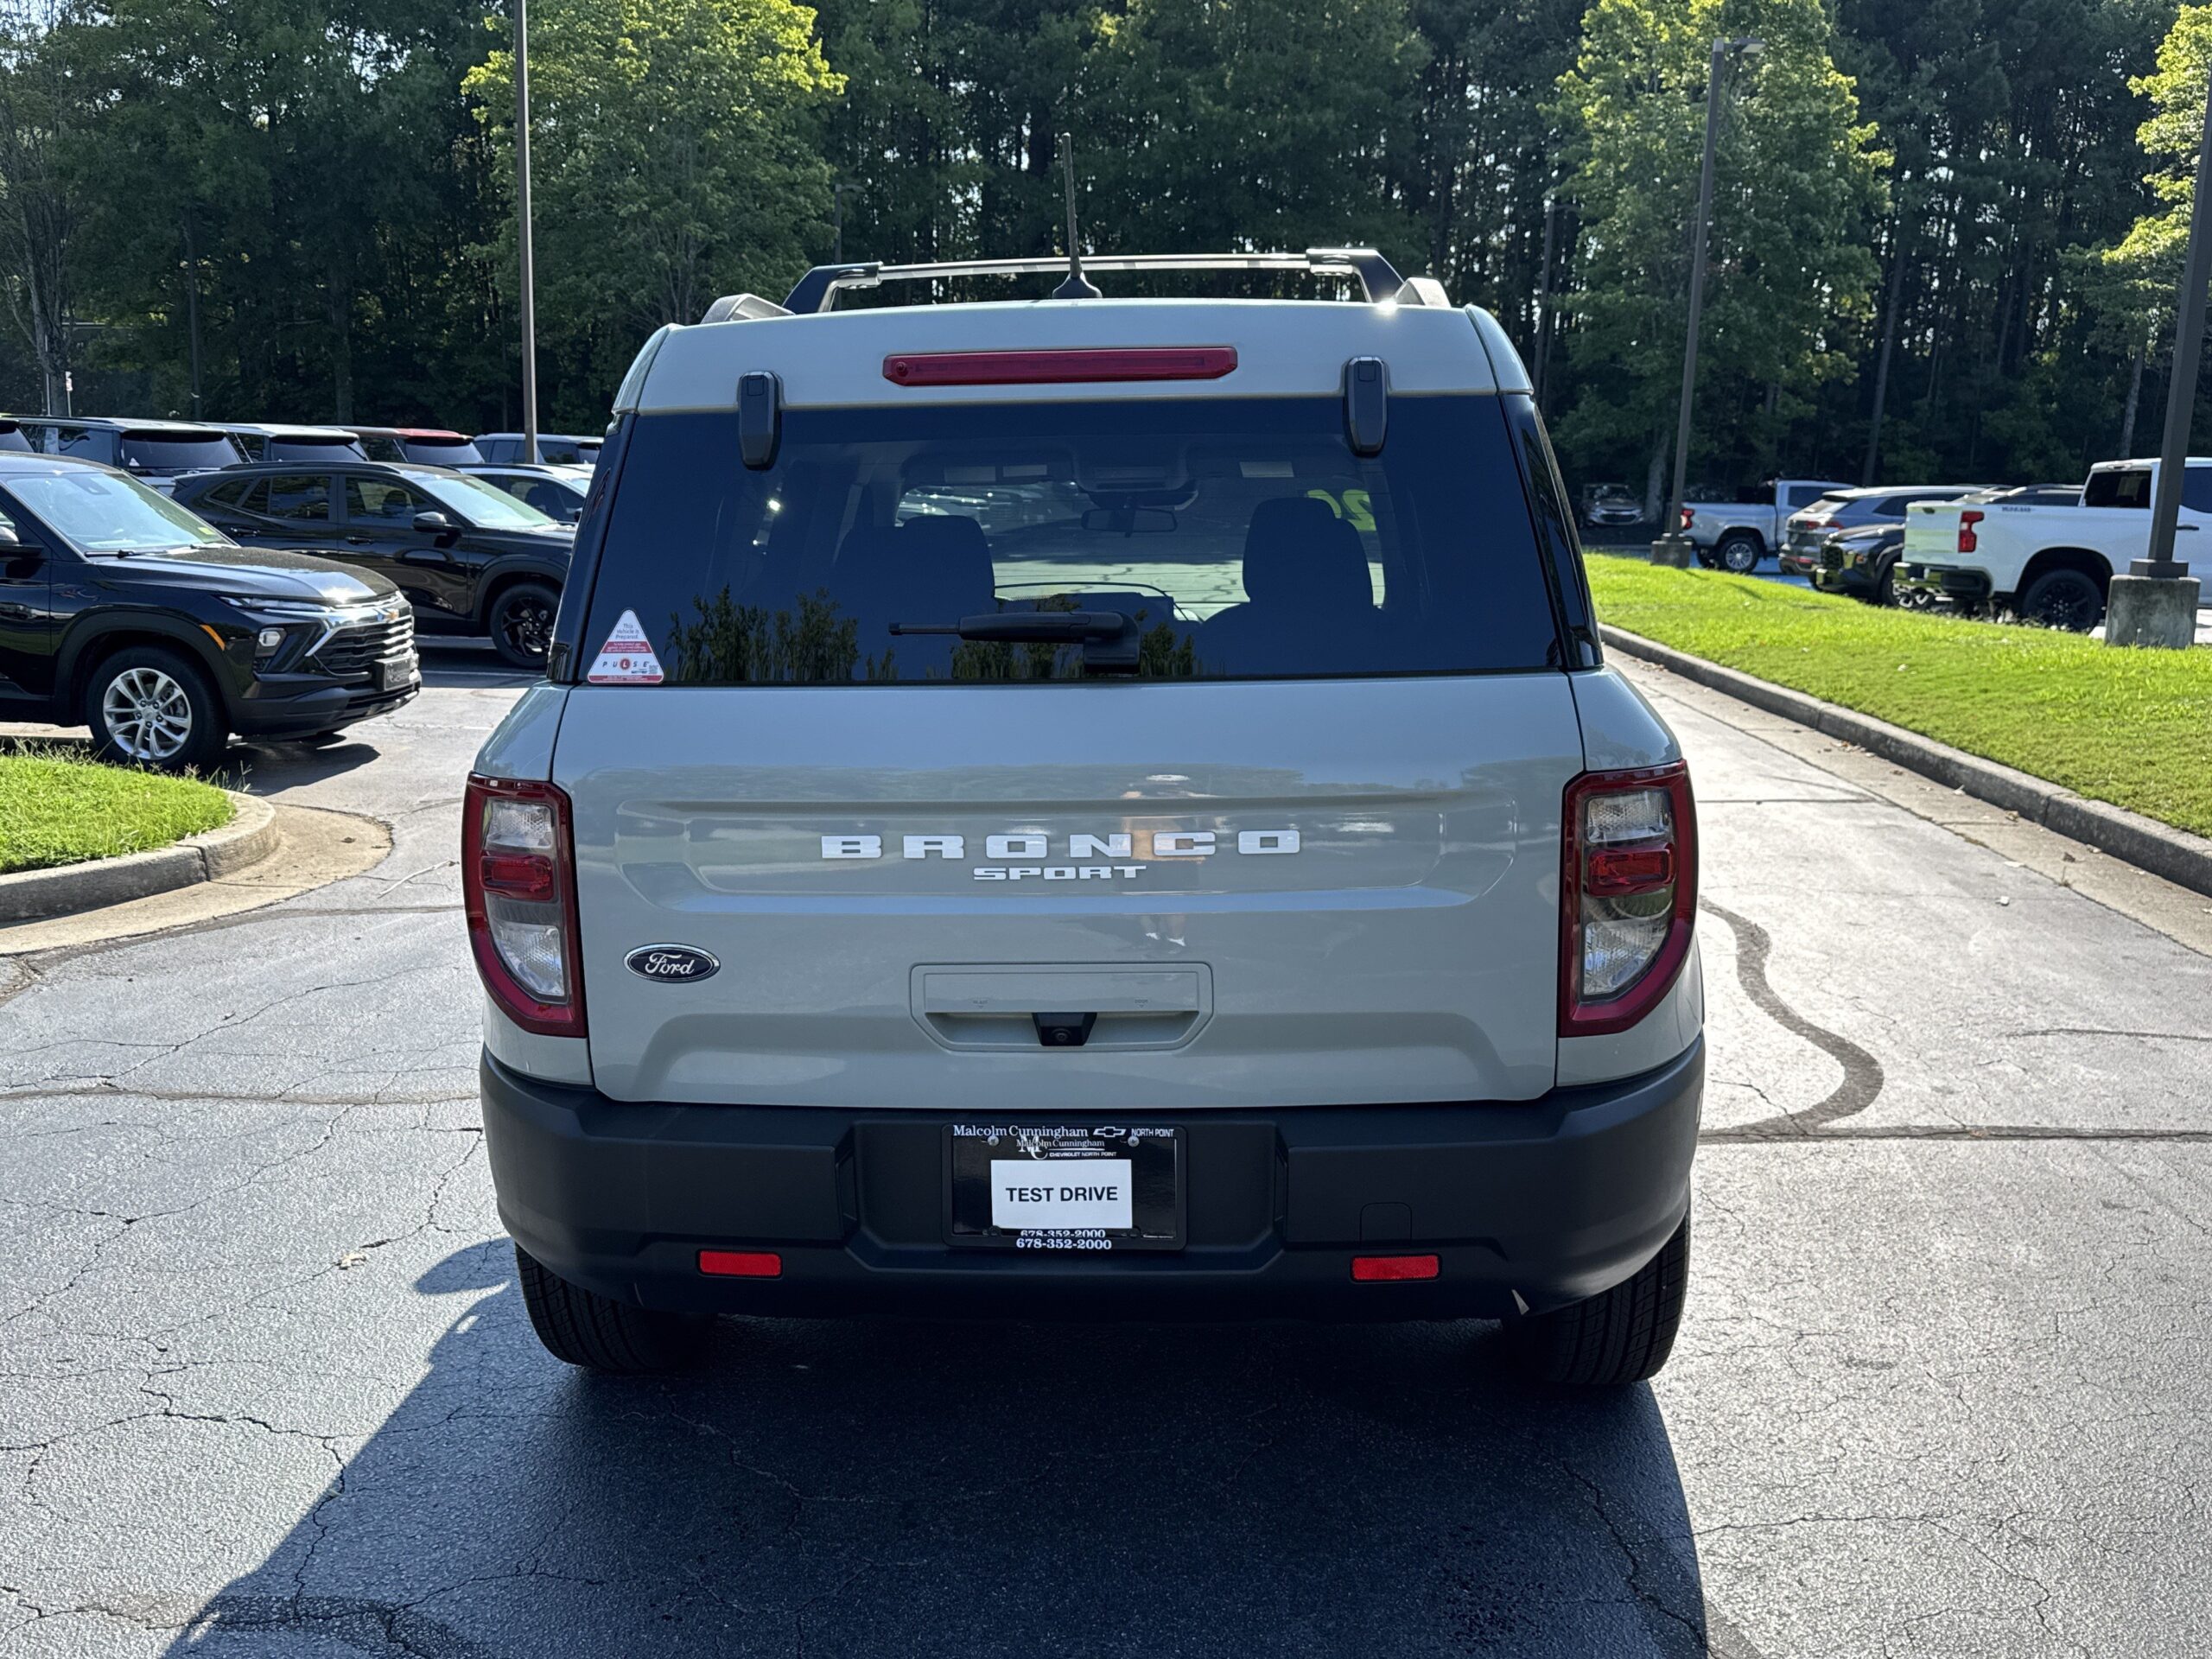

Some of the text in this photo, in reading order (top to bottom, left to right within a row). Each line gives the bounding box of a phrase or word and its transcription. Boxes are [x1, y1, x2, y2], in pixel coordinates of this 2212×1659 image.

[821, 830, 1300, 859] BRONCO
[974, 865, 1147, 880] SPORT
[645, 952, 695, 975] Ford
[953, 1125, 1174, 1139] Malcolm Cunningham NORTH POINT
[1052, 1140, 1105, 1149] Cunningham
[1005, 1186, 1118, 1203] TEST DRIVE
[1016, 1238, 1112, 1250] 678-352-2000
